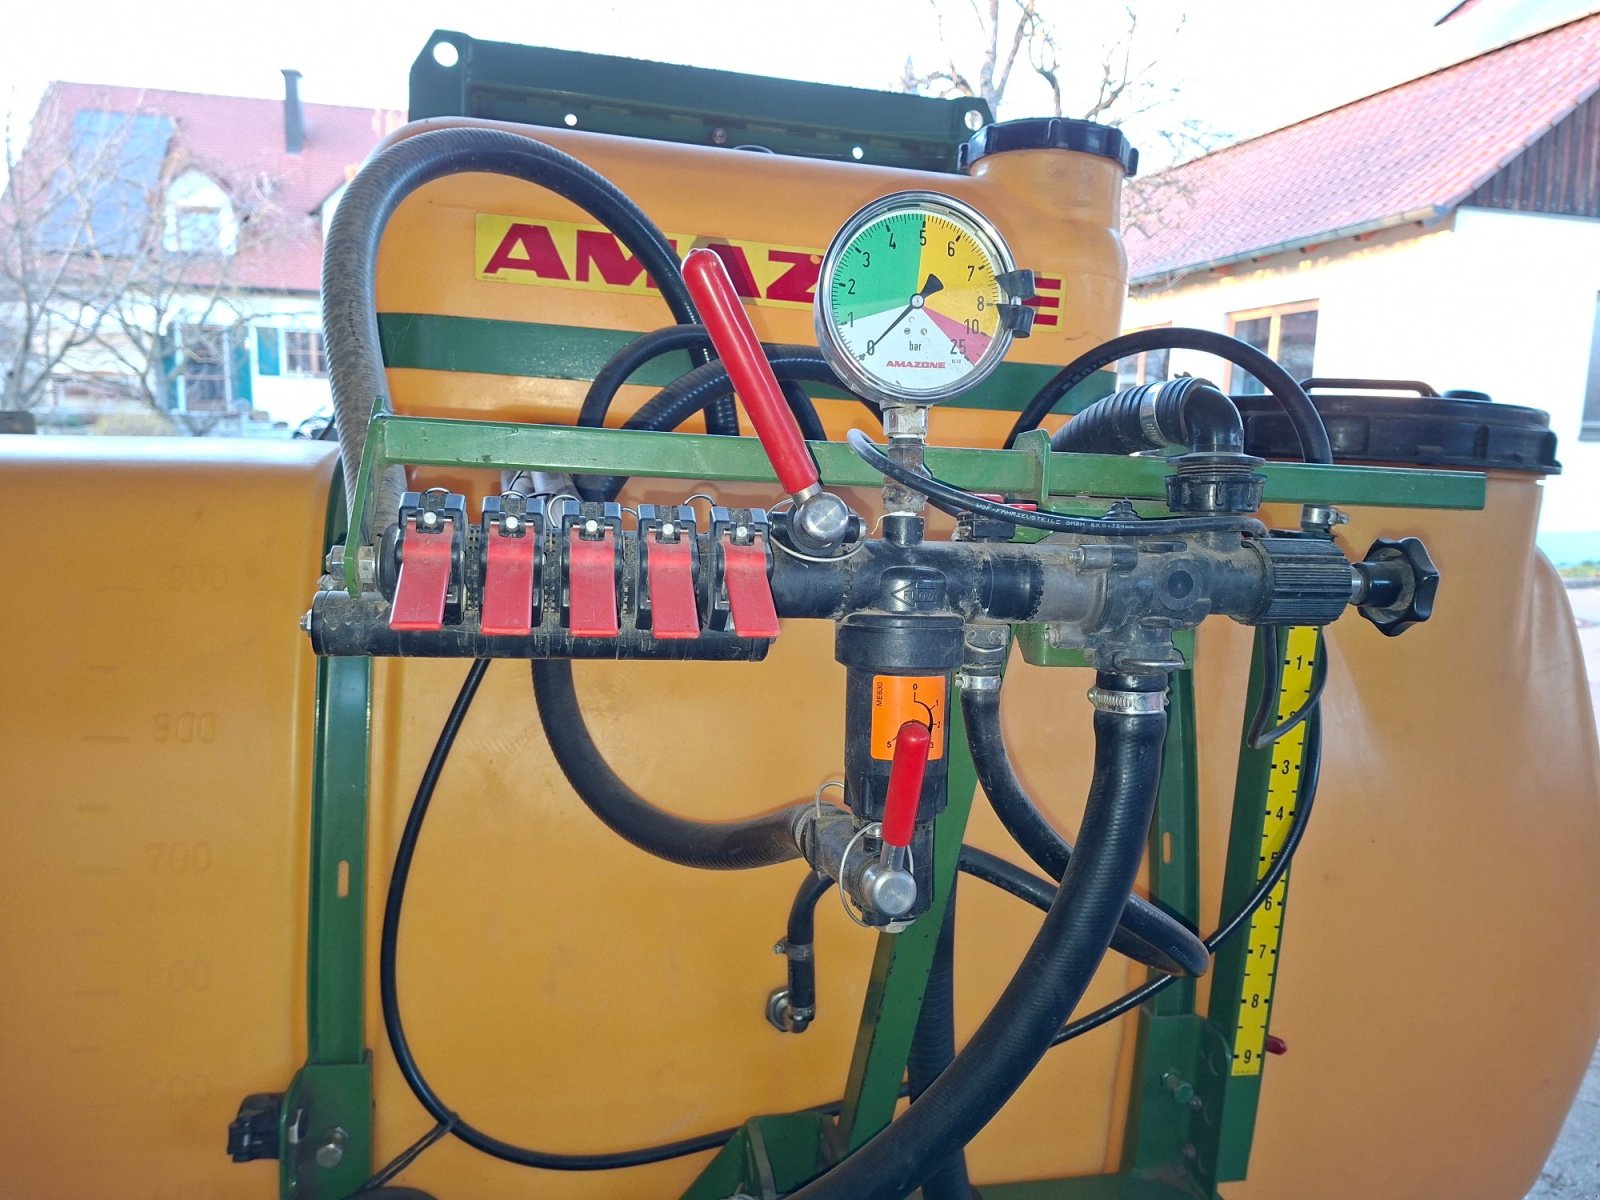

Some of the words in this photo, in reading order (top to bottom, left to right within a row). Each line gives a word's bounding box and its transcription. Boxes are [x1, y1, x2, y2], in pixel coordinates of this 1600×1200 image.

[888, 233, 897, 250] 4
[919, 229, 927, 246] 5
[947, 241, 955, 257] 6
[862, 251, 871, 268] 3
[967, 265, 975, 281] 7
[847, 278, 856, 295] 2
[976, 296, 985, 312] 8
[847, 311, 855, 328] 1
[964, 318, 980, 335] 10
[866, 339, 875, 356] 0
[908, 340, 922, 352] bar
[950, 339, 967, 355] 25
[885, 360, 946, 369] AMAZONE
[1296, 655, 1303, 670] 1
[912, 683, 918, 691] 0
[150, 712, 218, 745] 800
[936, 721, 941, 729] 2
[886, 740, 892, 748] 5
[1281, 759, 1290, 775] 3
[1276, 805, 1284, 821] 4
[1264, 895, 1273, 911] 6
[1259, 944, 1267, 959] 7
[1251, 993, 1259, 1009] 8
[1244, 1049, 1252, 1064] 9
